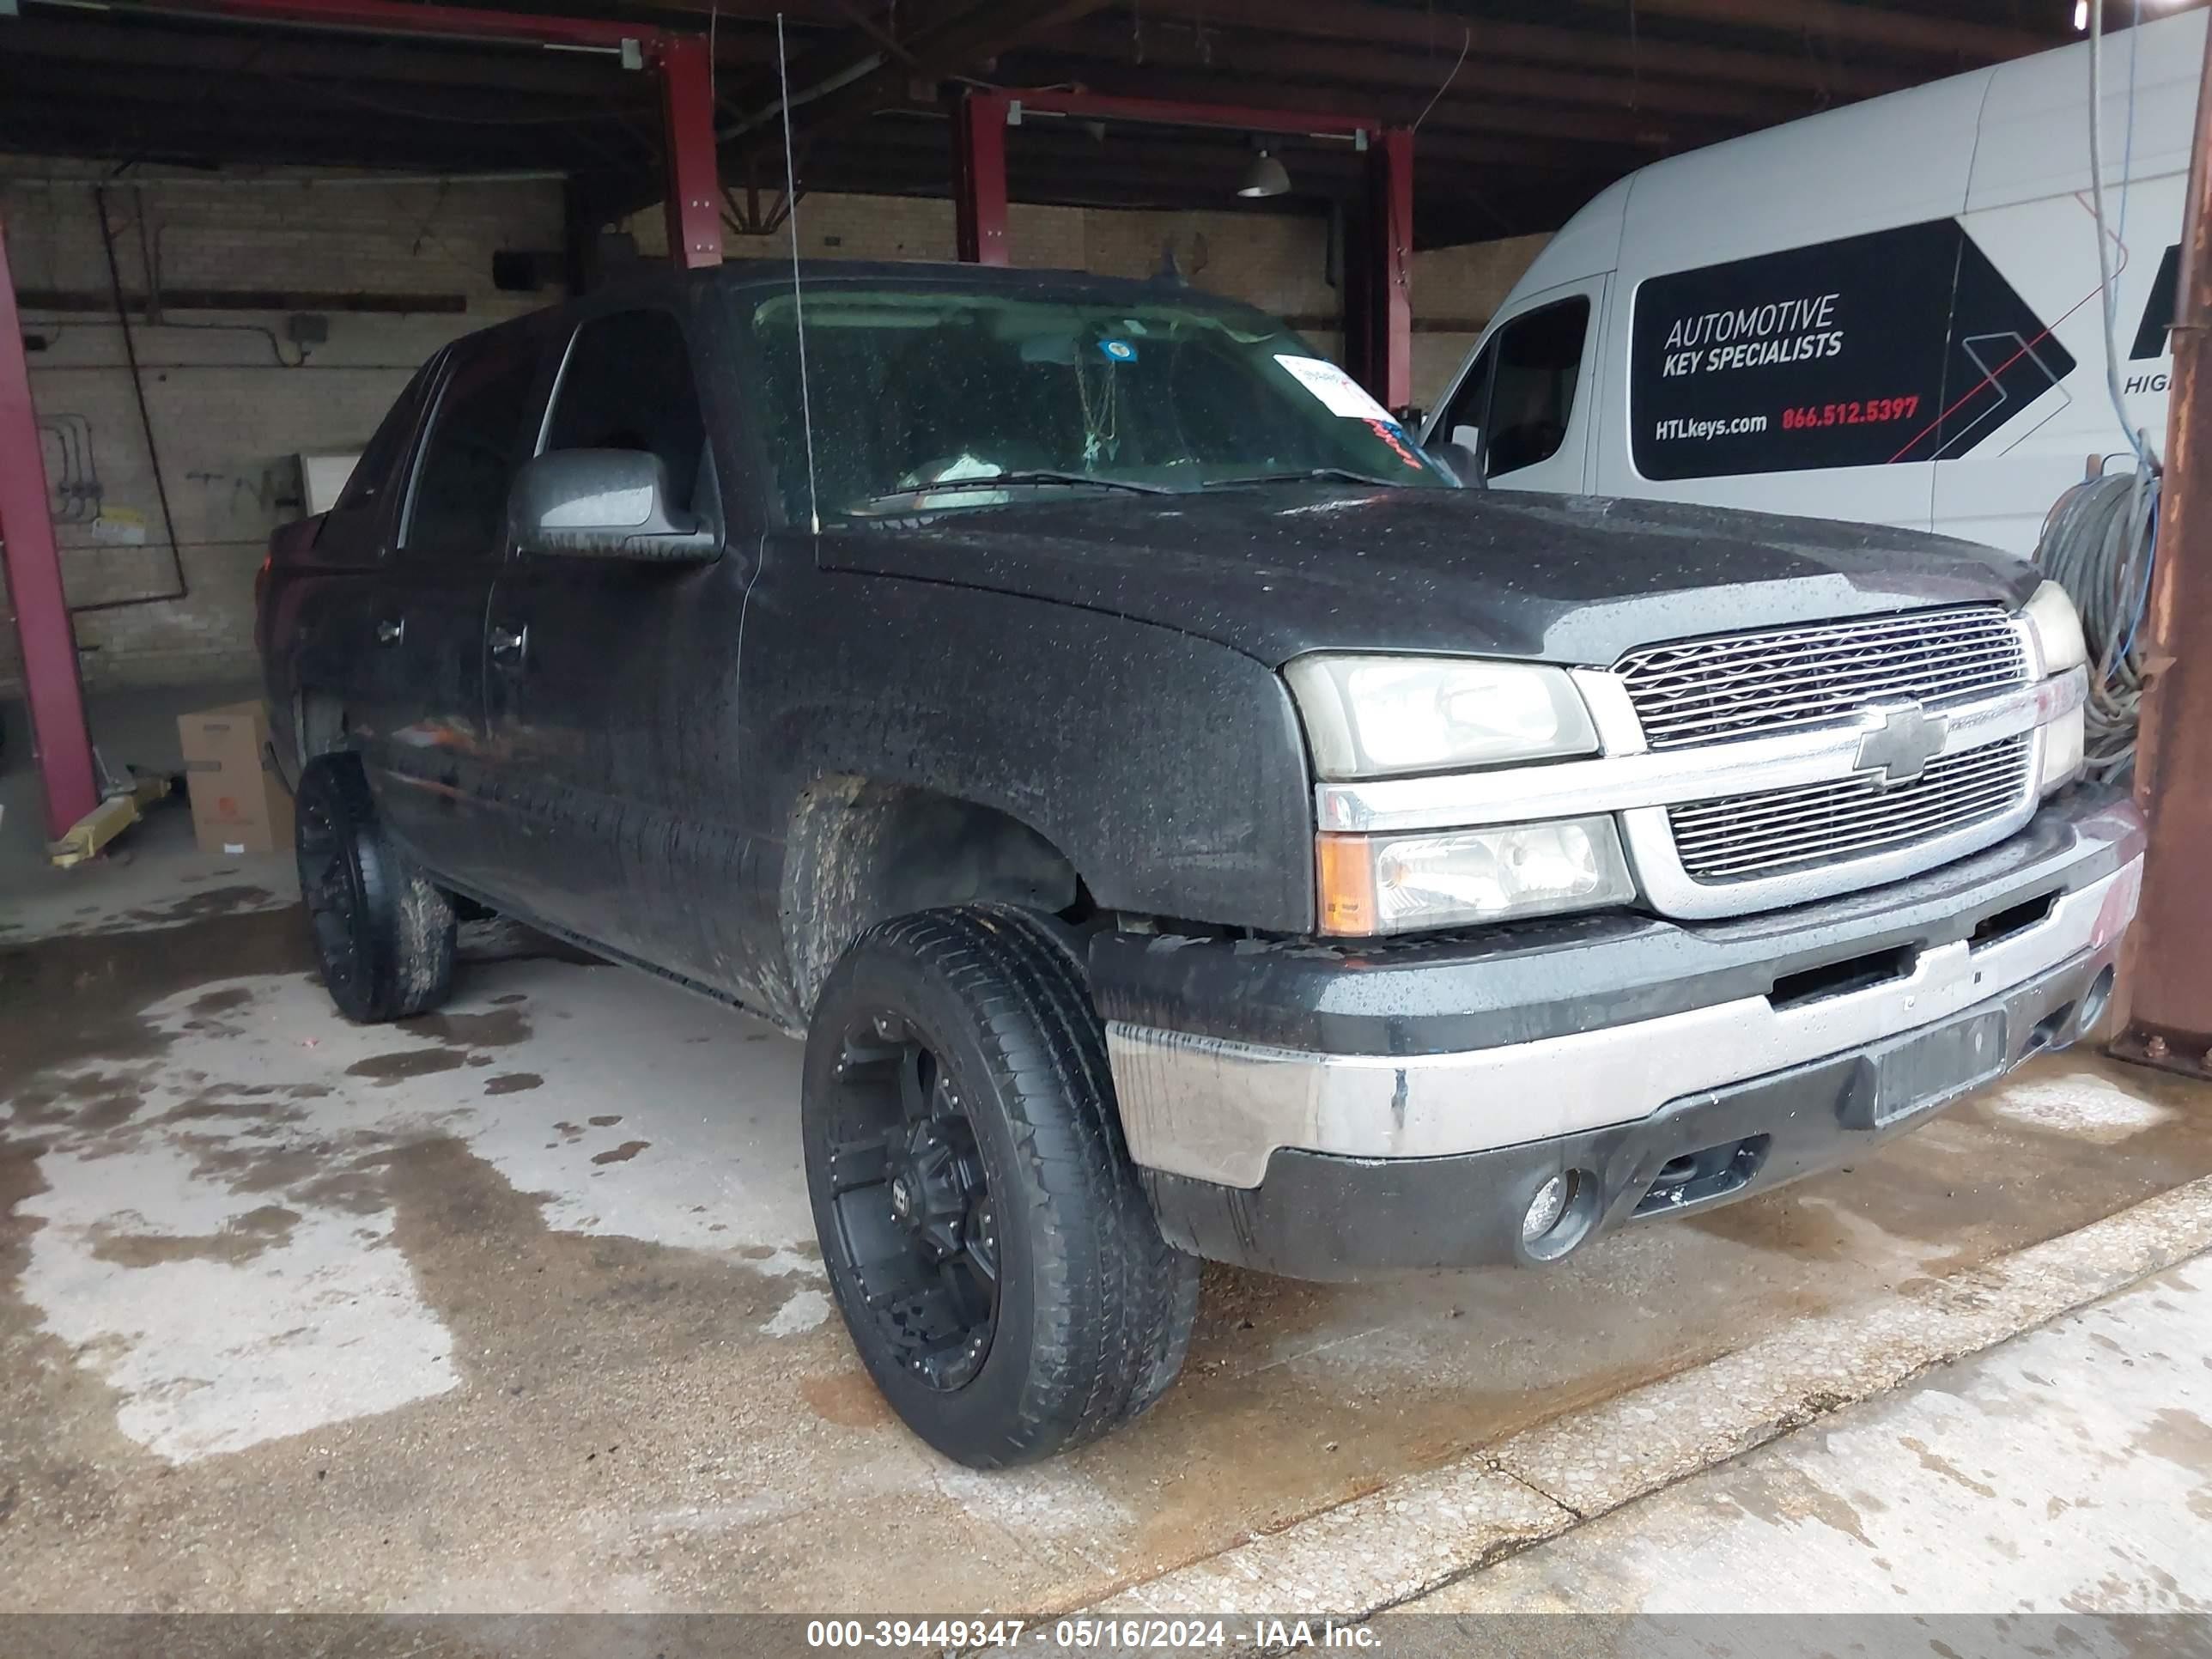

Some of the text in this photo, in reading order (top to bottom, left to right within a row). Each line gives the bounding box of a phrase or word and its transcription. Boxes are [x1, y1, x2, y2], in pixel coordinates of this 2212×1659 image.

[1663, 293, 1840, 350] AUTOMOTIVE
[1662, 331, 1844, 378] KEY SPECIALISTS
[2124, 374, 2172, 394] HIG
[1655, 395, 1920, 441] HTLkeys.com 866.512.5397
